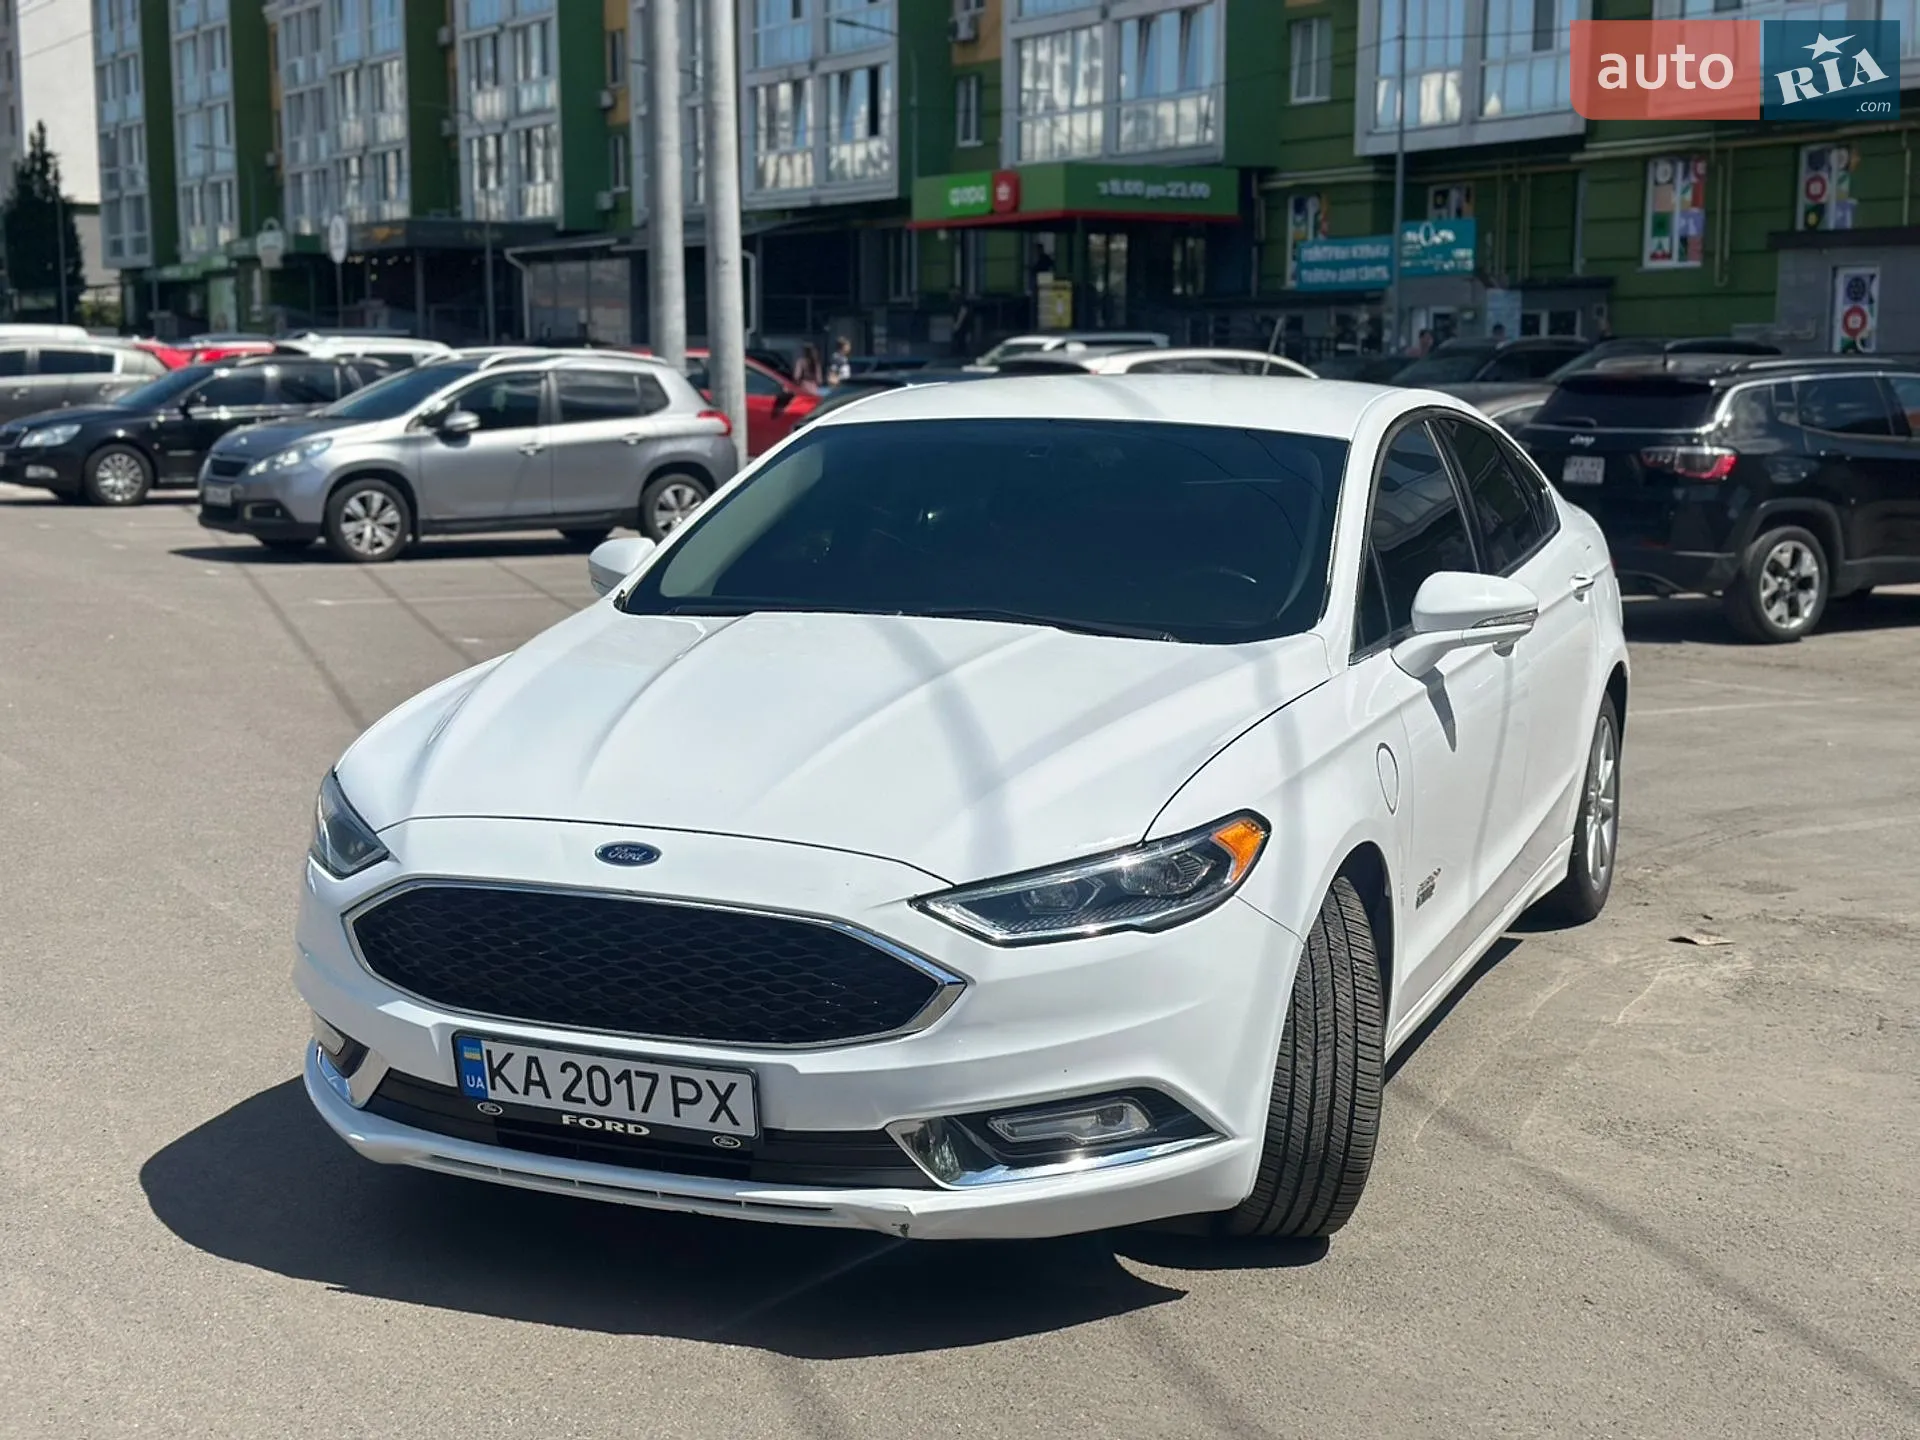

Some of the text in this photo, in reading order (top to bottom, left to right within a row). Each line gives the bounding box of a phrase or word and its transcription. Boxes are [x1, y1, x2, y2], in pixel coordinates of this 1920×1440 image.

[466, 1074, 486, 1090] UA
[486, 1049, 740, 1126] KA 2017 PX
[560, 1114, 651, 1136] FORD
